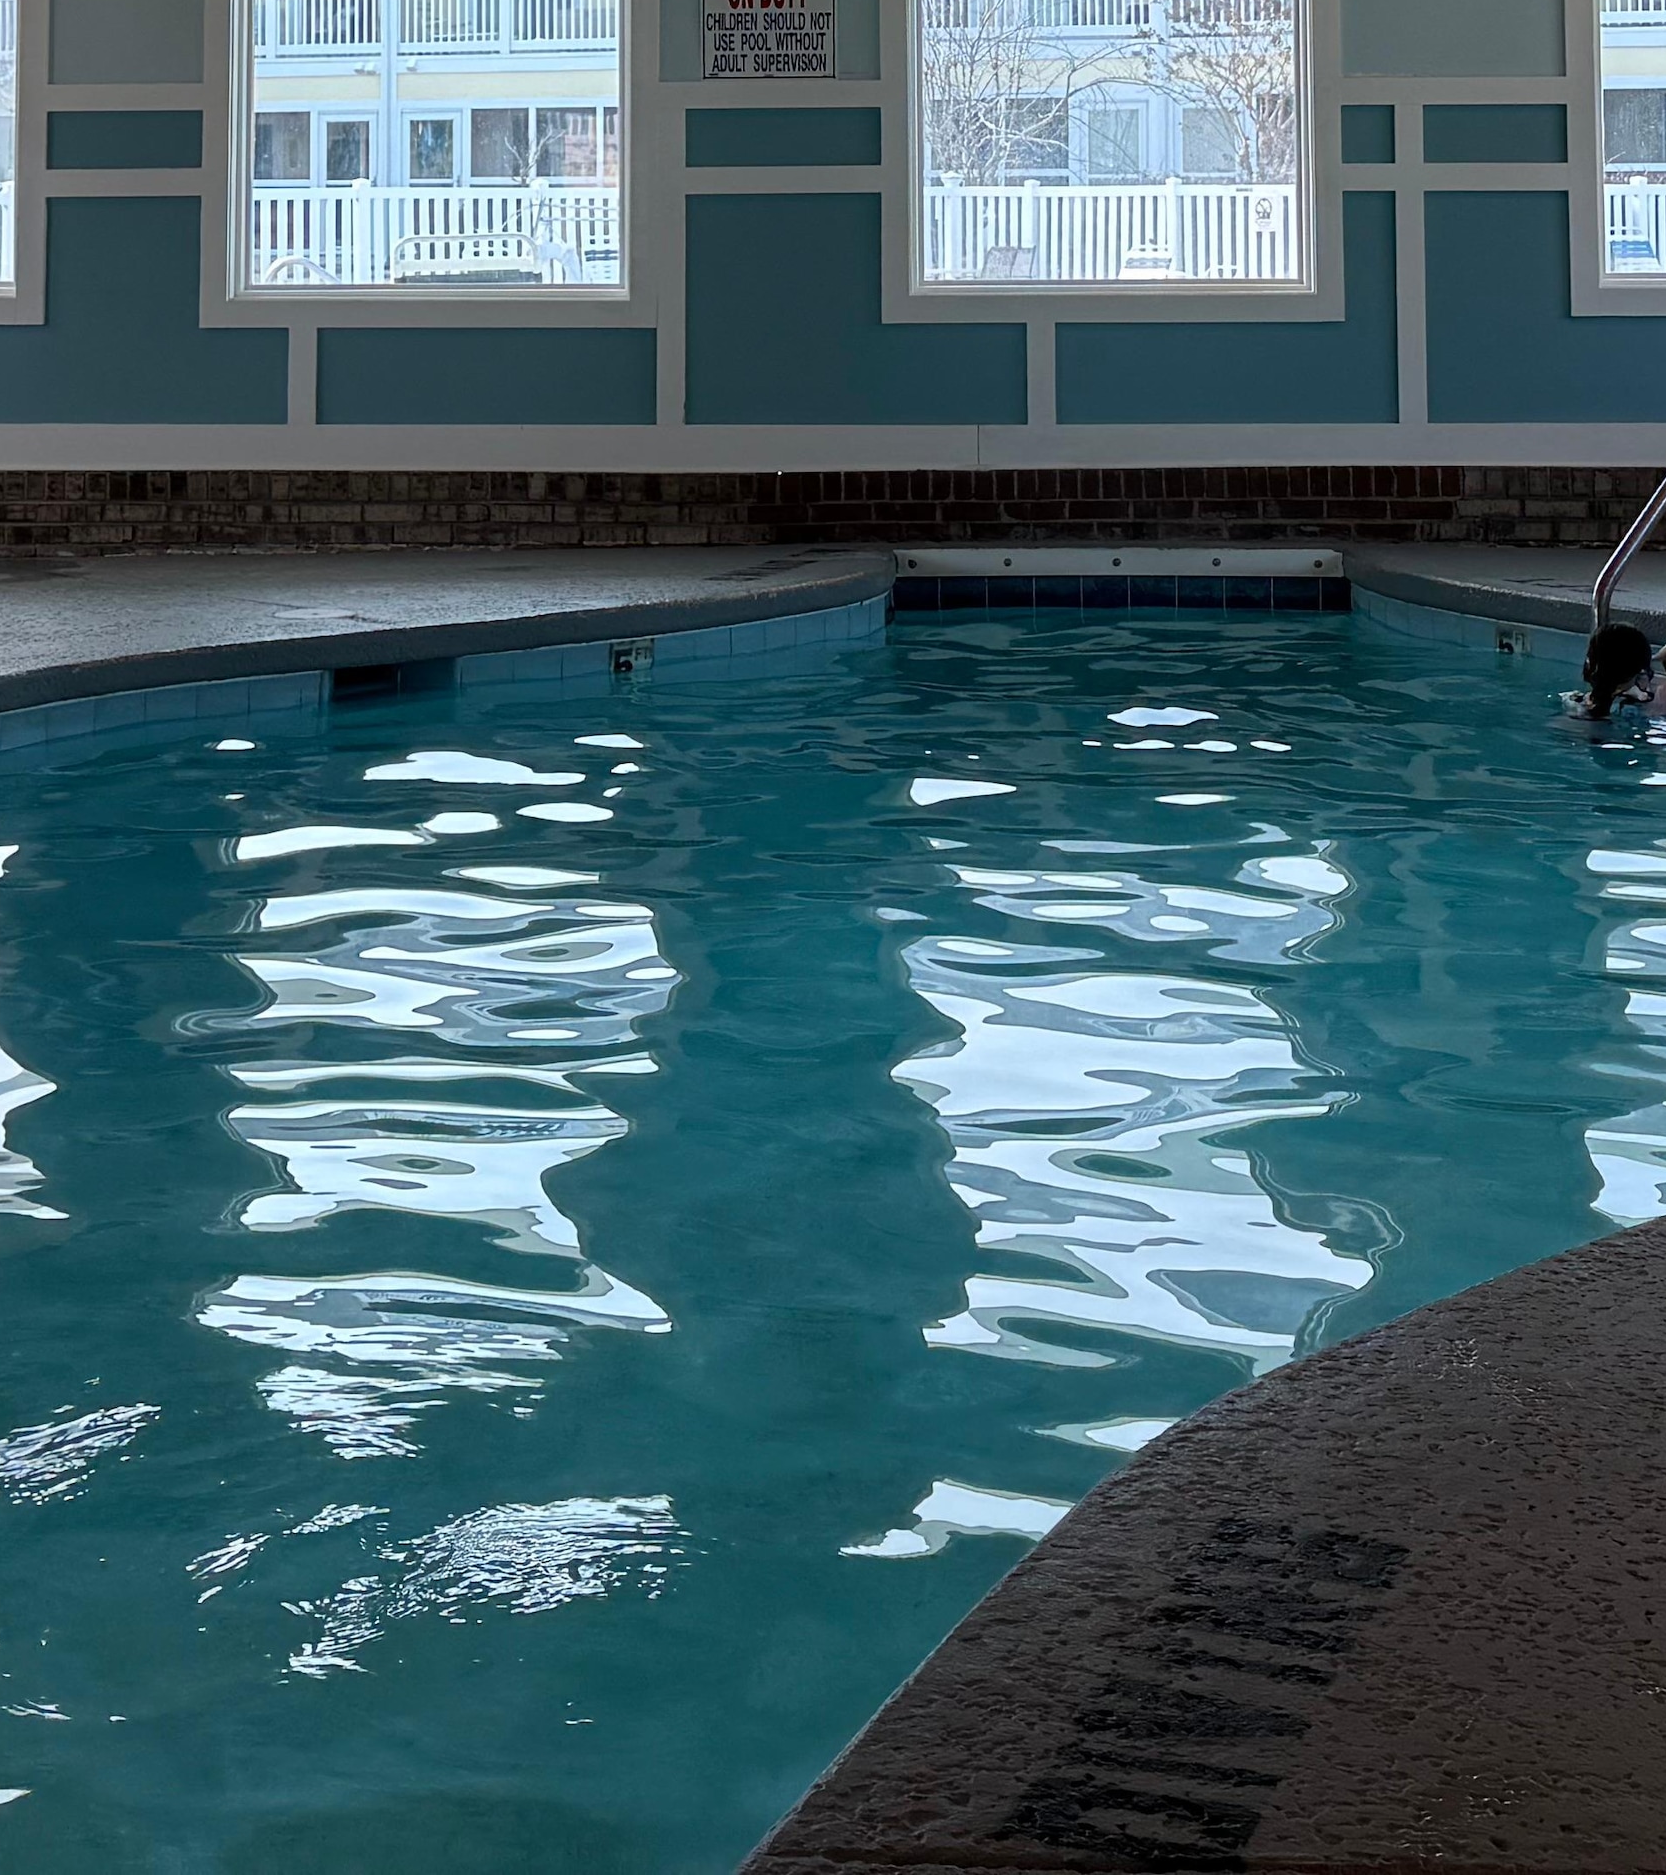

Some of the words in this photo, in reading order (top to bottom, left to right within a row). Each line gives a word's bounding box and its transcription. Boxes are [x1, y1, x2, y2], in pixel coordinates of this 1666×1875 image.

[706, 13, 757, 30] CHILDREN
[764, 13, 805, 30] SHOULD
[811, 12, 831, 29] NOT
[714, 33, 734, 51] USE
[741, 33, 771, 51] POOL
[776, 32, 826, 50] WITHOUT
[712, 54, 747, 72] ADULT
[754, 53, 826, 72] SUPERVISION
[614, 647, 633, 672] 5
[635, 646, 651, 661] FT
